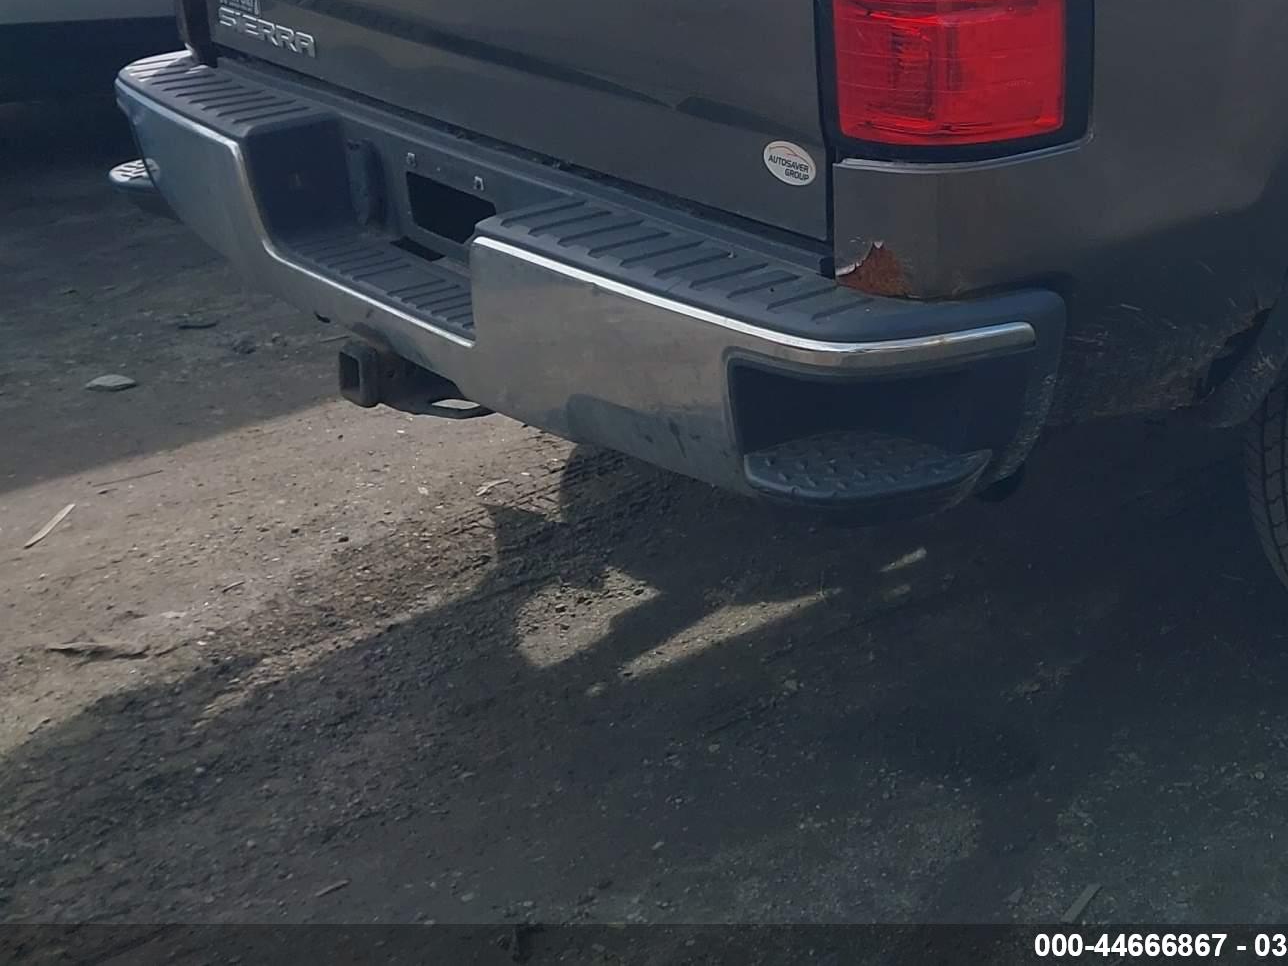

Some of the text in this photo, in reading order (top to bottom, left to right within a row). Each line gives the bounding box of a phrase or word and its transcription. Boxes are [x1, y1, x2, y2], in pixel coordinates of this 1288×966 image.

[219, 6, 316, 58] SIERRA
[768, 154, 809, 174] AUTOSAVER
[784, 168, 810, 181] GROUP
